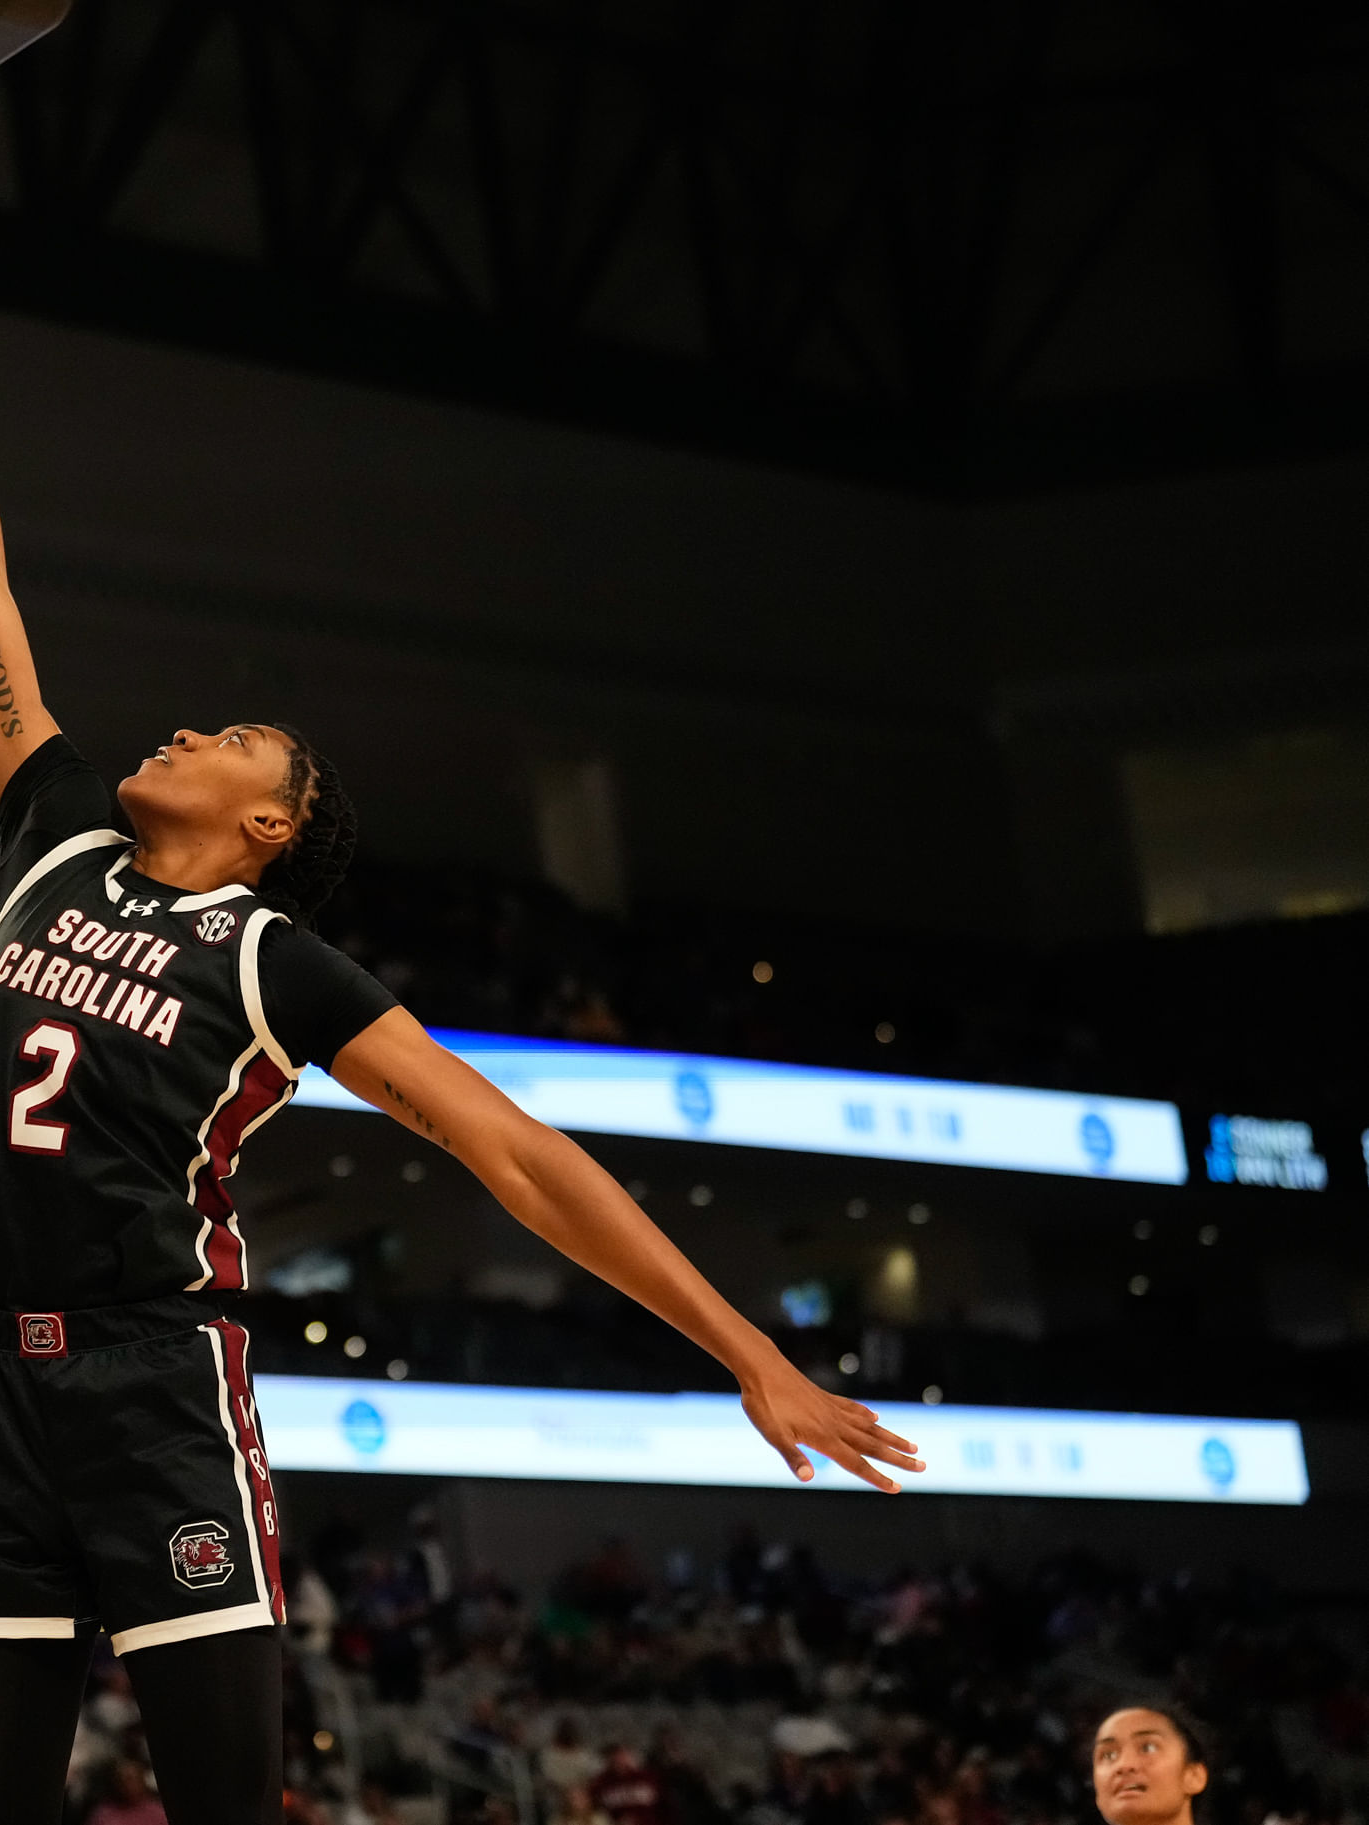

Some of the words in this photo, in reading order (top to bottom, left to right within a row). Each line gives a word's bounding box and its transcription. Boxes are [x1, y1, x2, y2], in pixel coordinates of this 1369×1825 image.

[47, 908, 180, 978] SOUTH
[195, 909, 236, 943] SEC
[8, 1017, 82, 1157] 2
